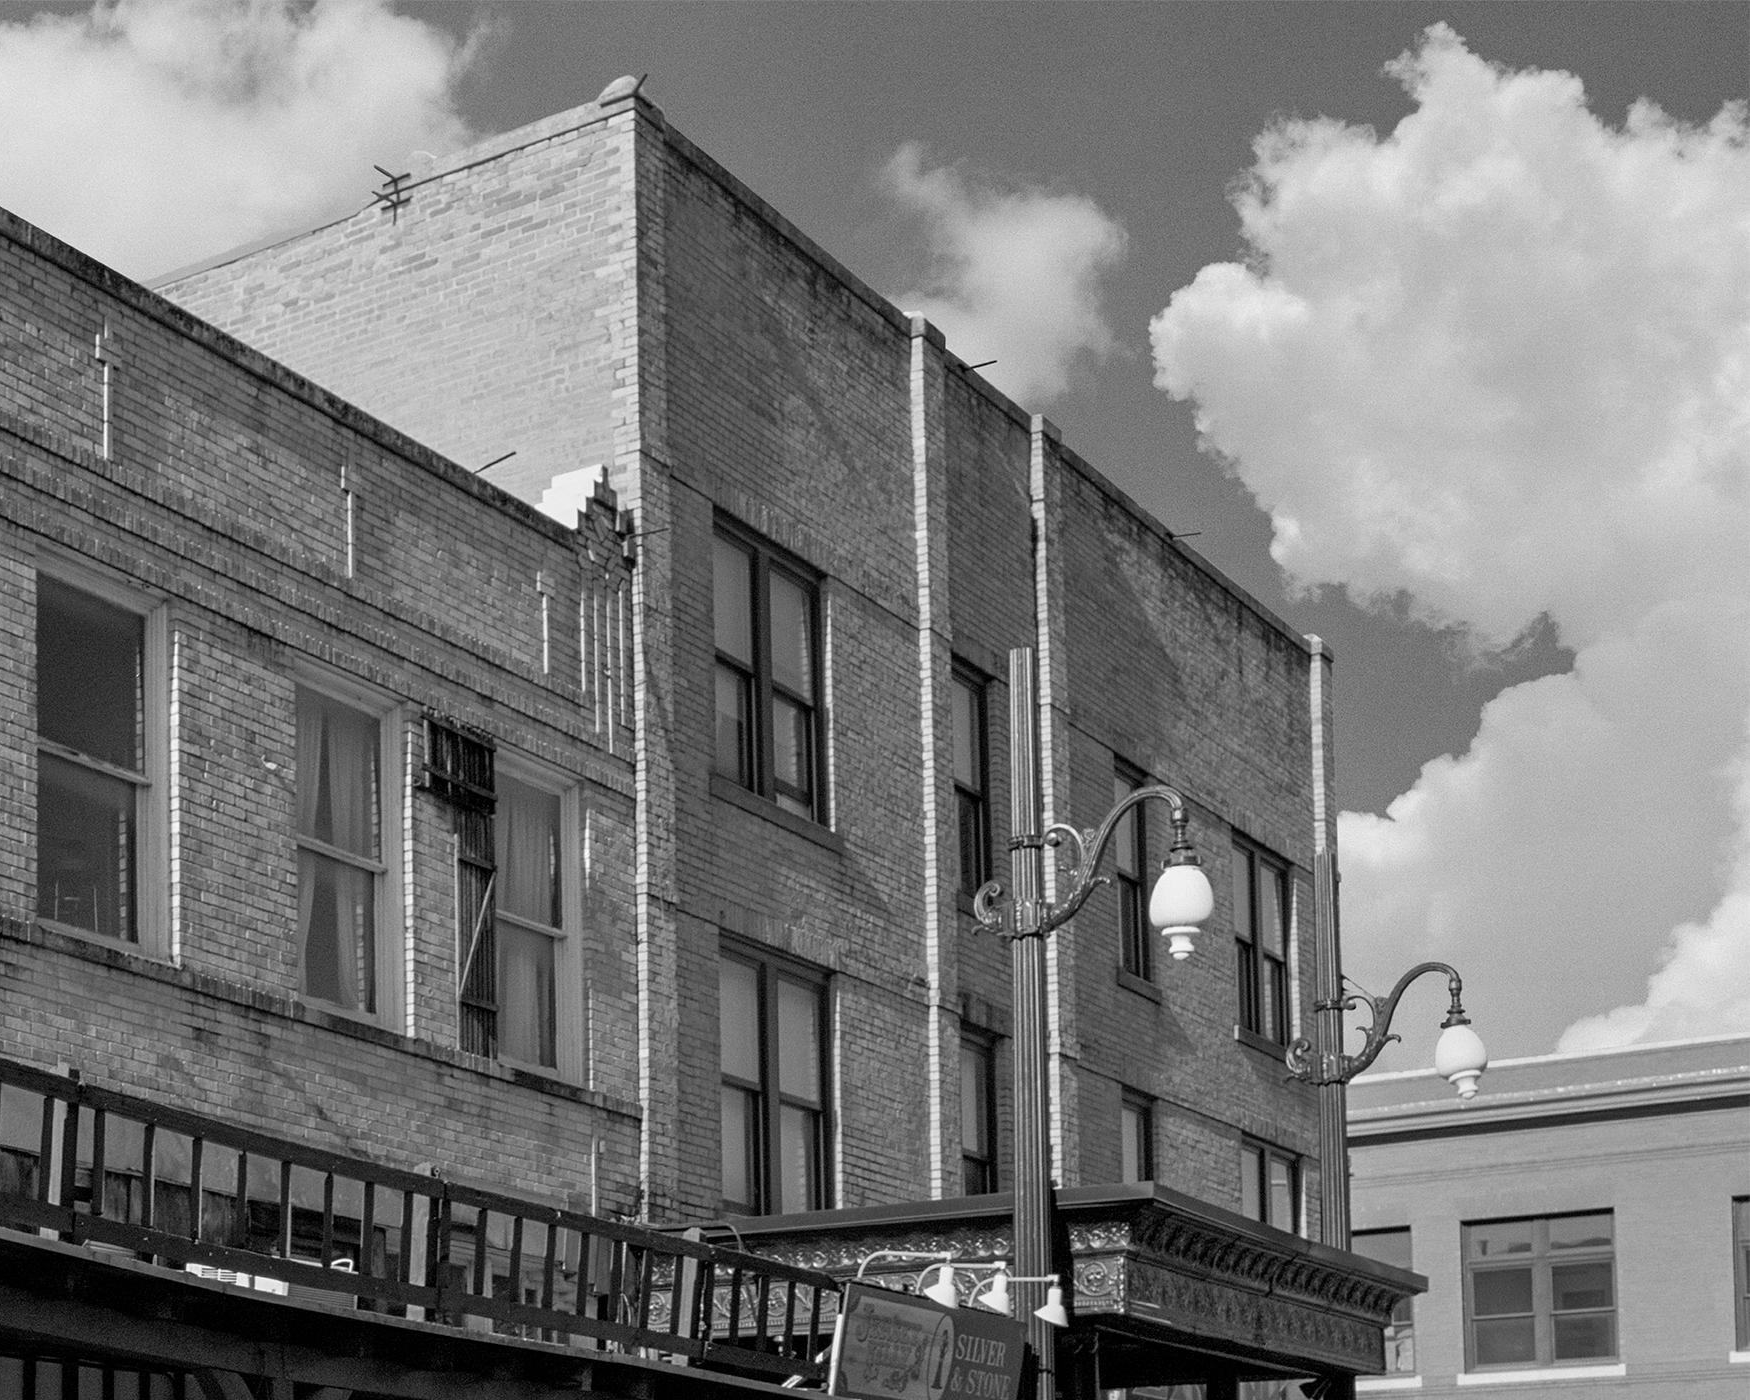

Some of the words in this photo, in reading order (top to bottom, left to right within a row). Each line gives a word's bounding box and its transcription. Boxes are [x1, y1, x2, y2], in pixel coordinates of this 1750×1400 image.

[954, 1333, 1007, 1368] SILVER
[949, 1366, 964, 1392] &
[965, 1369, 1012, 1400] STONE
